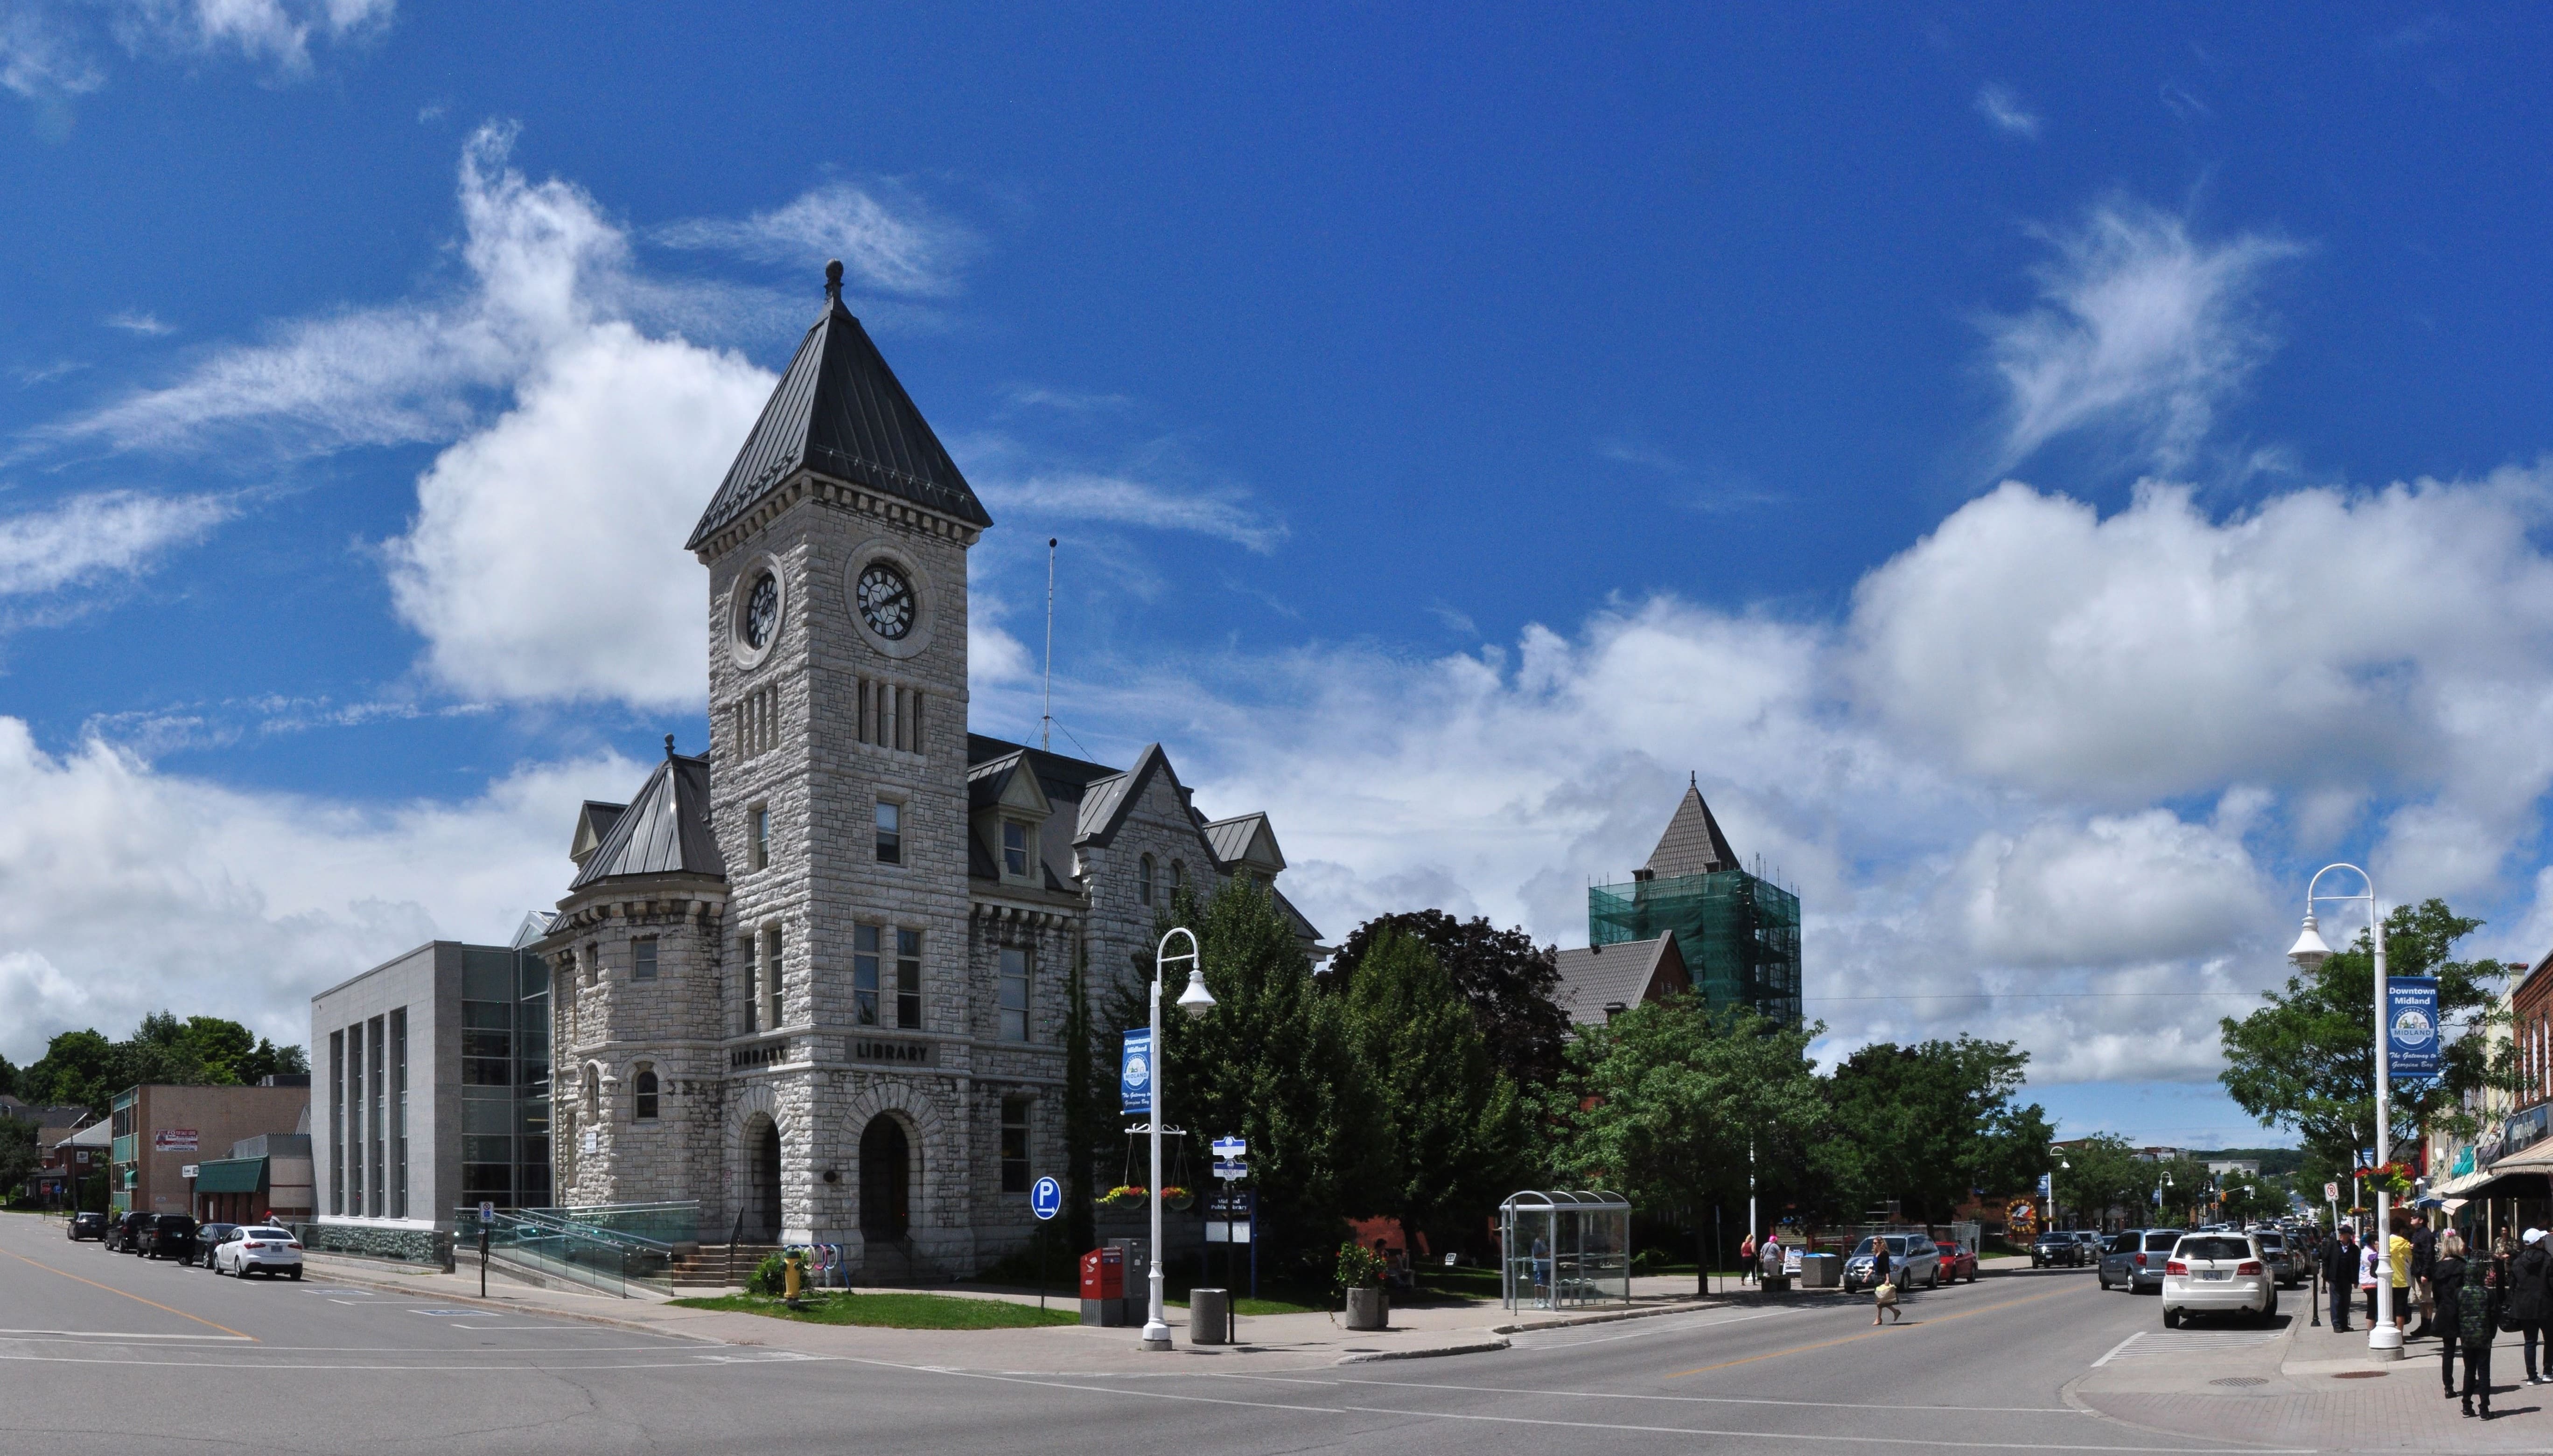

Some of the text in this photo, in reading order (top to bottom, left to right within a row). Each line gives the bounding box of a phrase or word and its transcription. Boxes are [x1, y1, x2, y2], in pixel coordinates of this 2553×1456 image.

[732, 1045, 785, 1066] LIBRARY
[857, 1043, 927, 1061] LIBRARY
[1040, 1182, 1053, 1206] P
